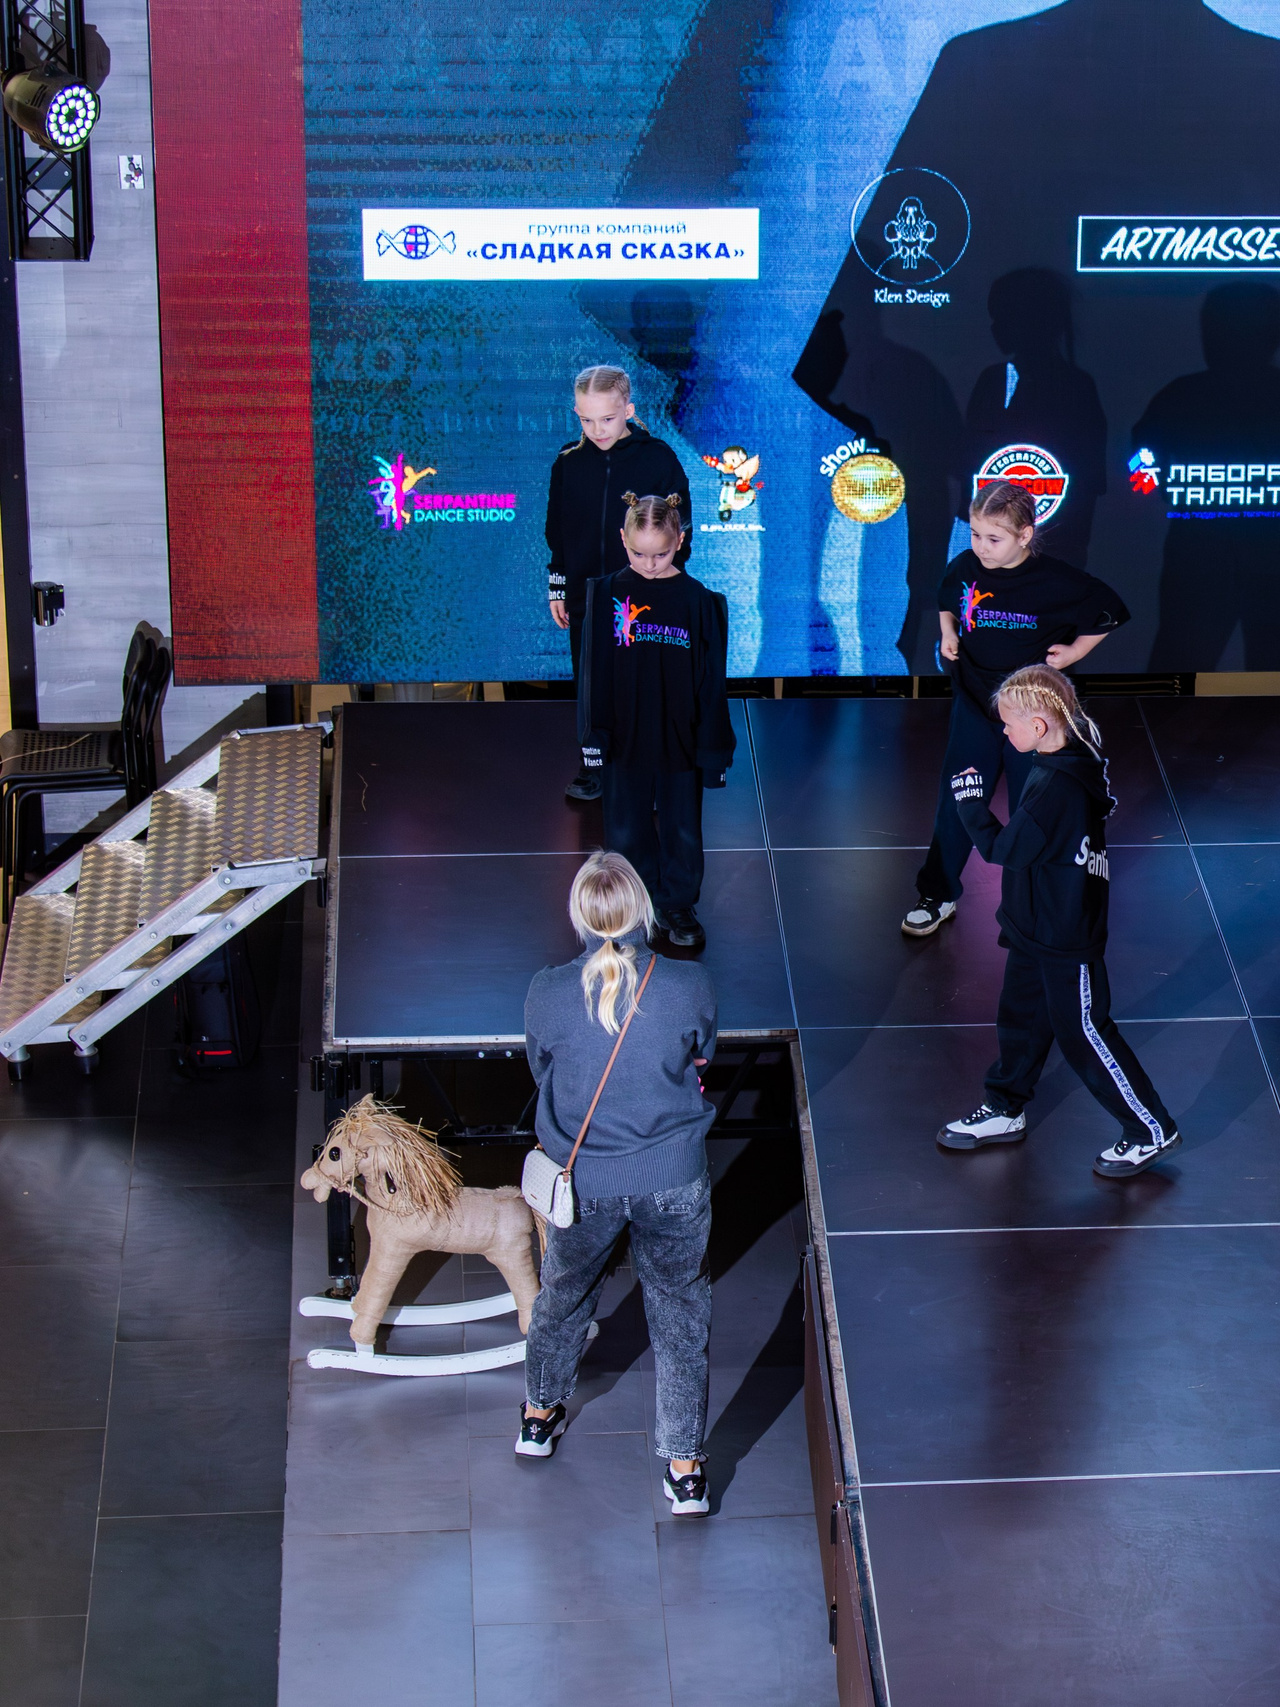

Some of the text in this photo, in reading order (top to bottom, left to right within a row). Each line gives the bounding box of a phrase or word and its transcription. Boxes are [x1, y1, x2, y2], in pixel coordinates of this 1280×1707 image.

[528, 221, 686, 237] группа компаний
[466, 242, 745, 263] «СЛАДКАЯ СКАЗКА»
[874, 287, 950, 308] Klen Design
[820, 438, 866, 478] show
[413, 494, 516, 509] SERPANTINE
[414, 509, 516, 522] DANCE STUDIO
[635, 623, 690, 640] SERPANTIN
[977, 619, 1007, 629] DANCE
[635, 633, 691, 649] DANCE STUDIO
